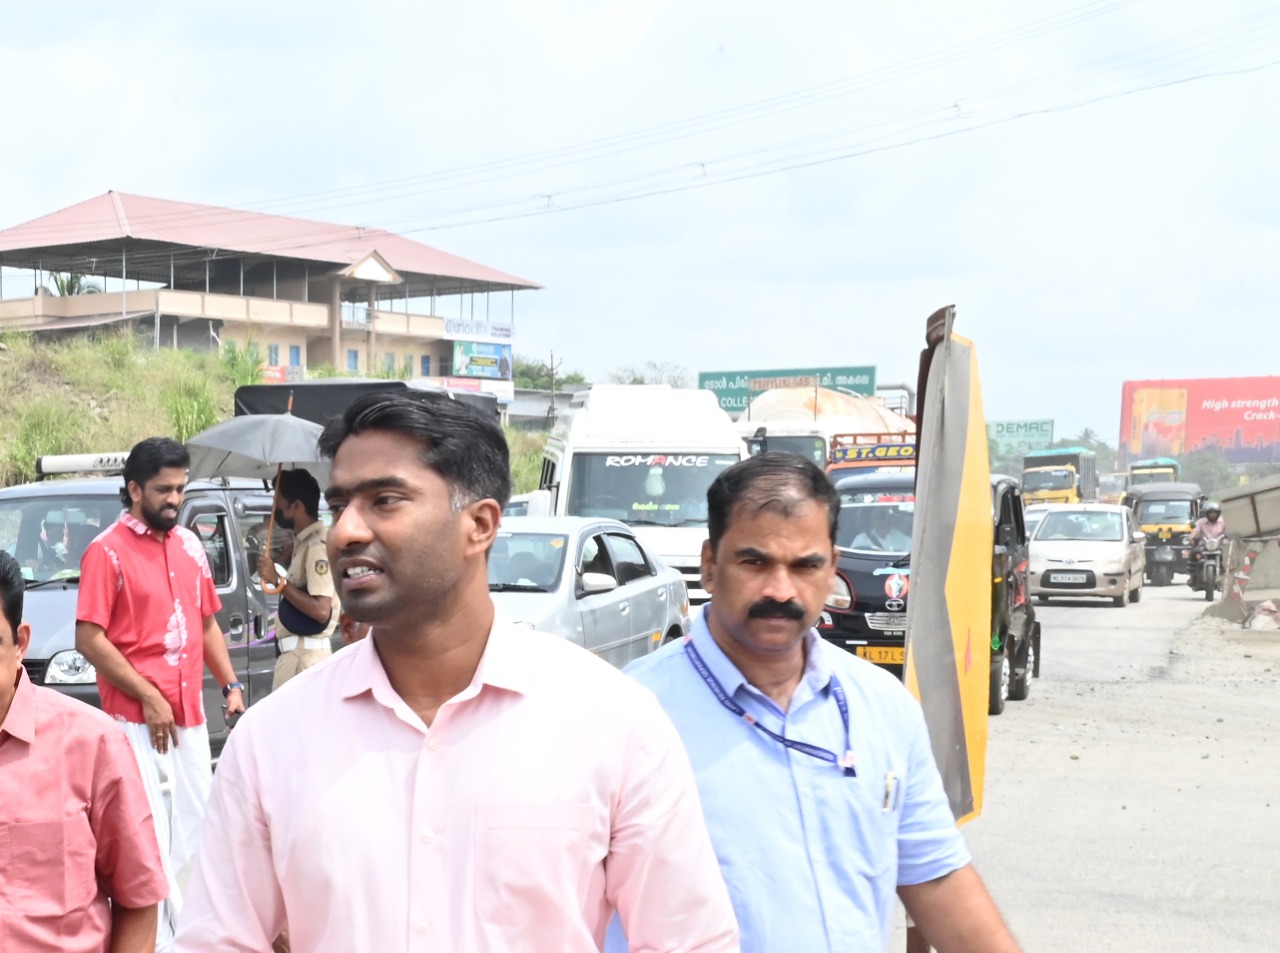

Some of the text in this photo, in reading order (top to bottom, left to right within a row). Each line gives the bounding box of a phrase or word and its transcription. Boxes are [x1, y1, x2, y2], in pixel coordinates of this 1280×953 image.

[721, 397, 748, 408] COLLE
[1202, 396, 1279, 410] High strength
[845, 444, 915, 460] ST.GEO
[605, 454, 710, 467] ROMANCE
[878, 650, 889, 661] 17
